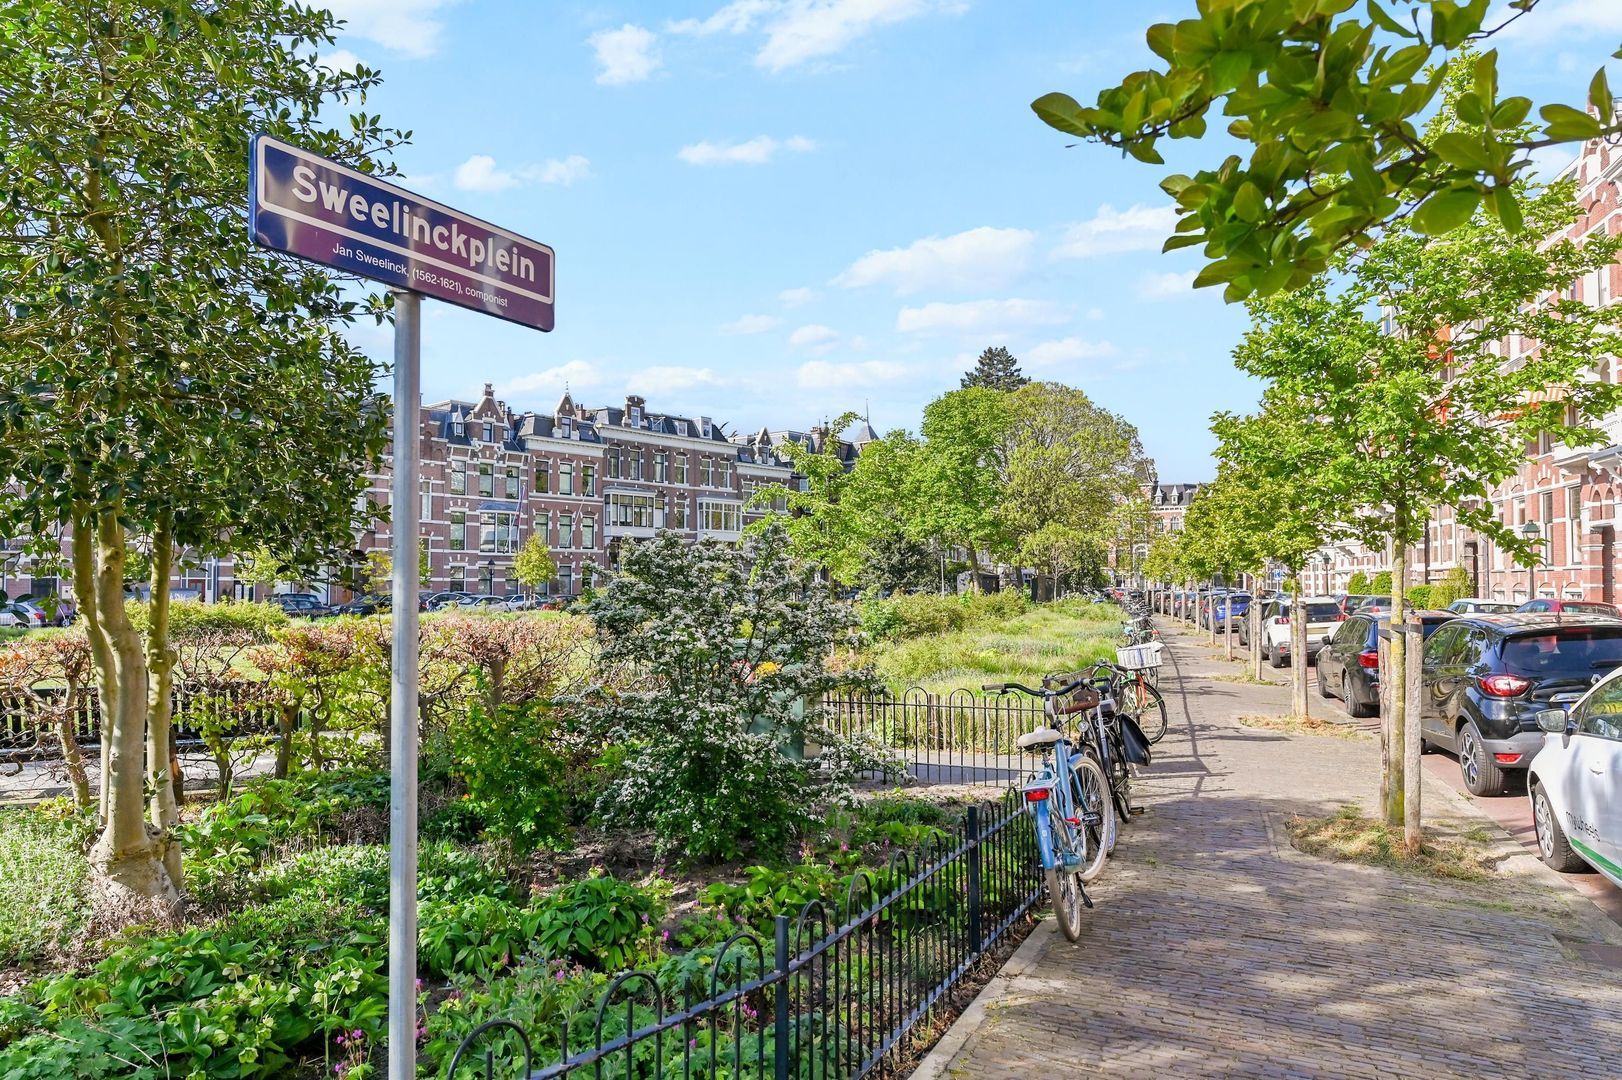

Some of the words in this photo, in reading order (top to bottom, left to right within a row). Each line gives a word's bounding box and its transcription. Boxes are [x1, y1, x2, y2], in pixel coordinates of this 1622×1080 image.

[292, 165, 535, 282] Sweelinckplein
[332, 242, 353, 258] Jan
[356, 249, 410, 277] Sweelinck,
[412, 268, 464, 294] (1562-1621),
[465, 287, 509, 308] componist
